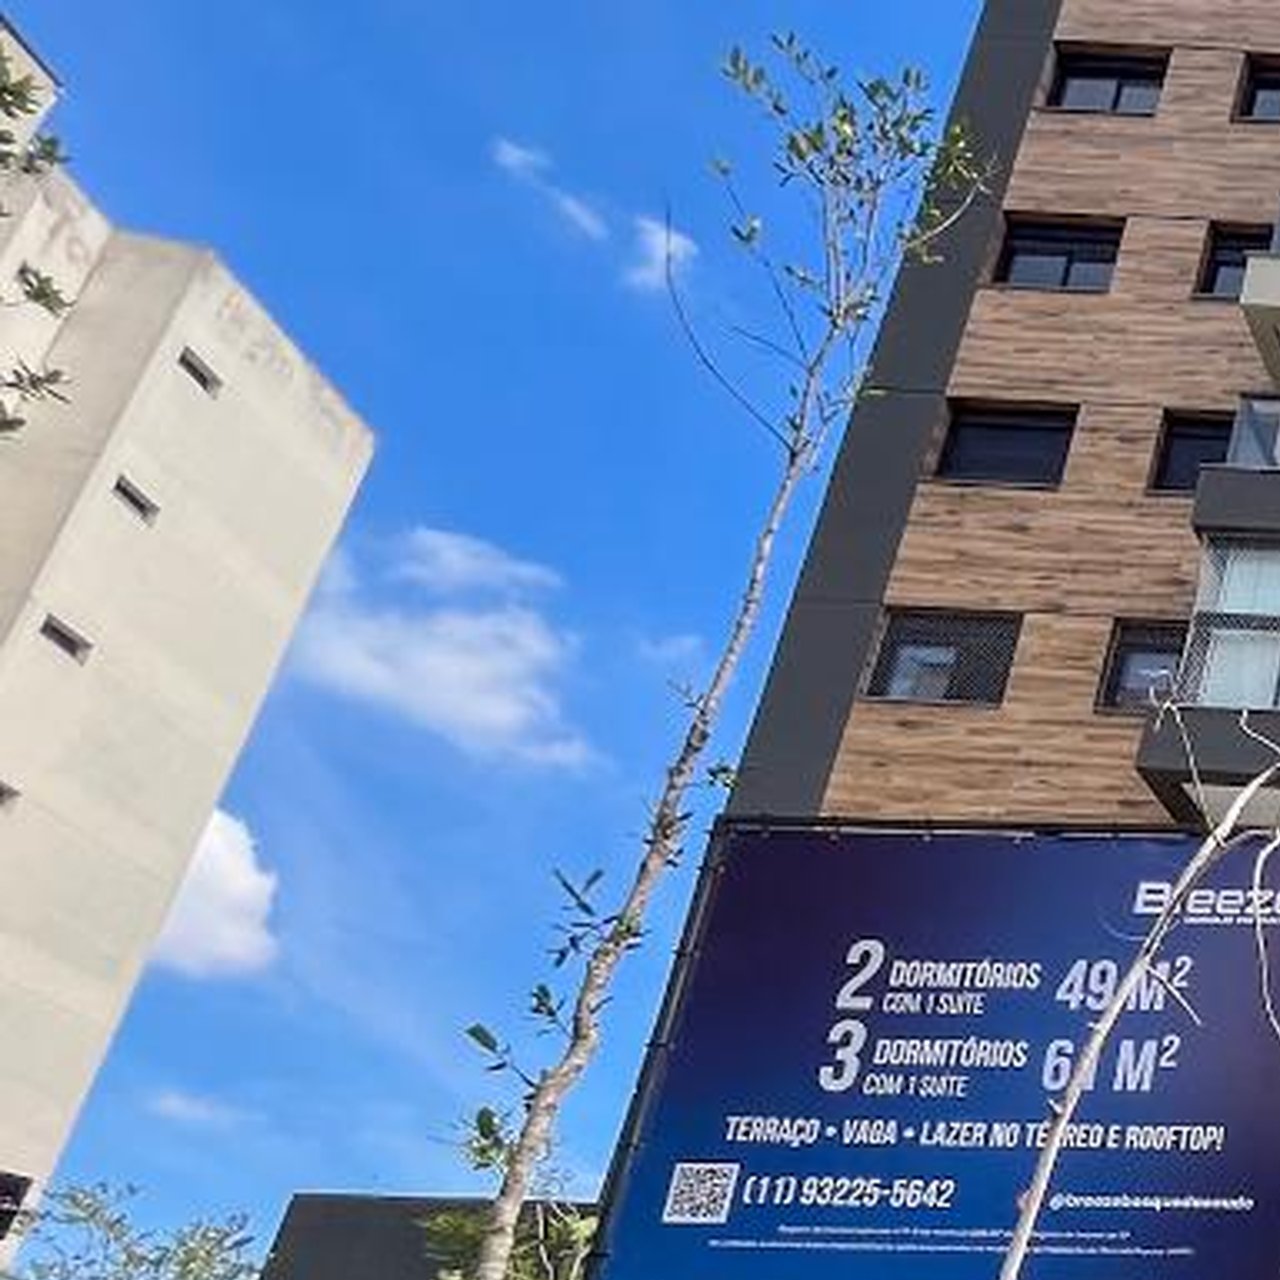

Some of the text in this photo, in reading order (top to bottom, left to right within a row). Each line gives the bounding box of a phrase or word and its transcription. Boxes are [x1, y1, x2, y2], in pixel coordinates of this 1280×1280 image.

[836, 939, 886, 1010] 2
[889, 955, 1042, 989] DORMITÓRIOS
[1055, 959, 1119, 1011] 49
[882, 992, 921, 1014] COM
[926, 993, 935, 1014] 1
[818, 1019, 868, 1092] 3
[873, 1036, 1029, 1068] DORMITÓRIOS
[863, 1073, 904, 1095] COM
[908, 1075, 917, 1095] 1
[725, 1116, 1225, 1151] TERRAÇO VAGA LAZER NO TÉREO E ROOFTOP!
[743, 1175, 956, 1209] (11) 93225-5642
